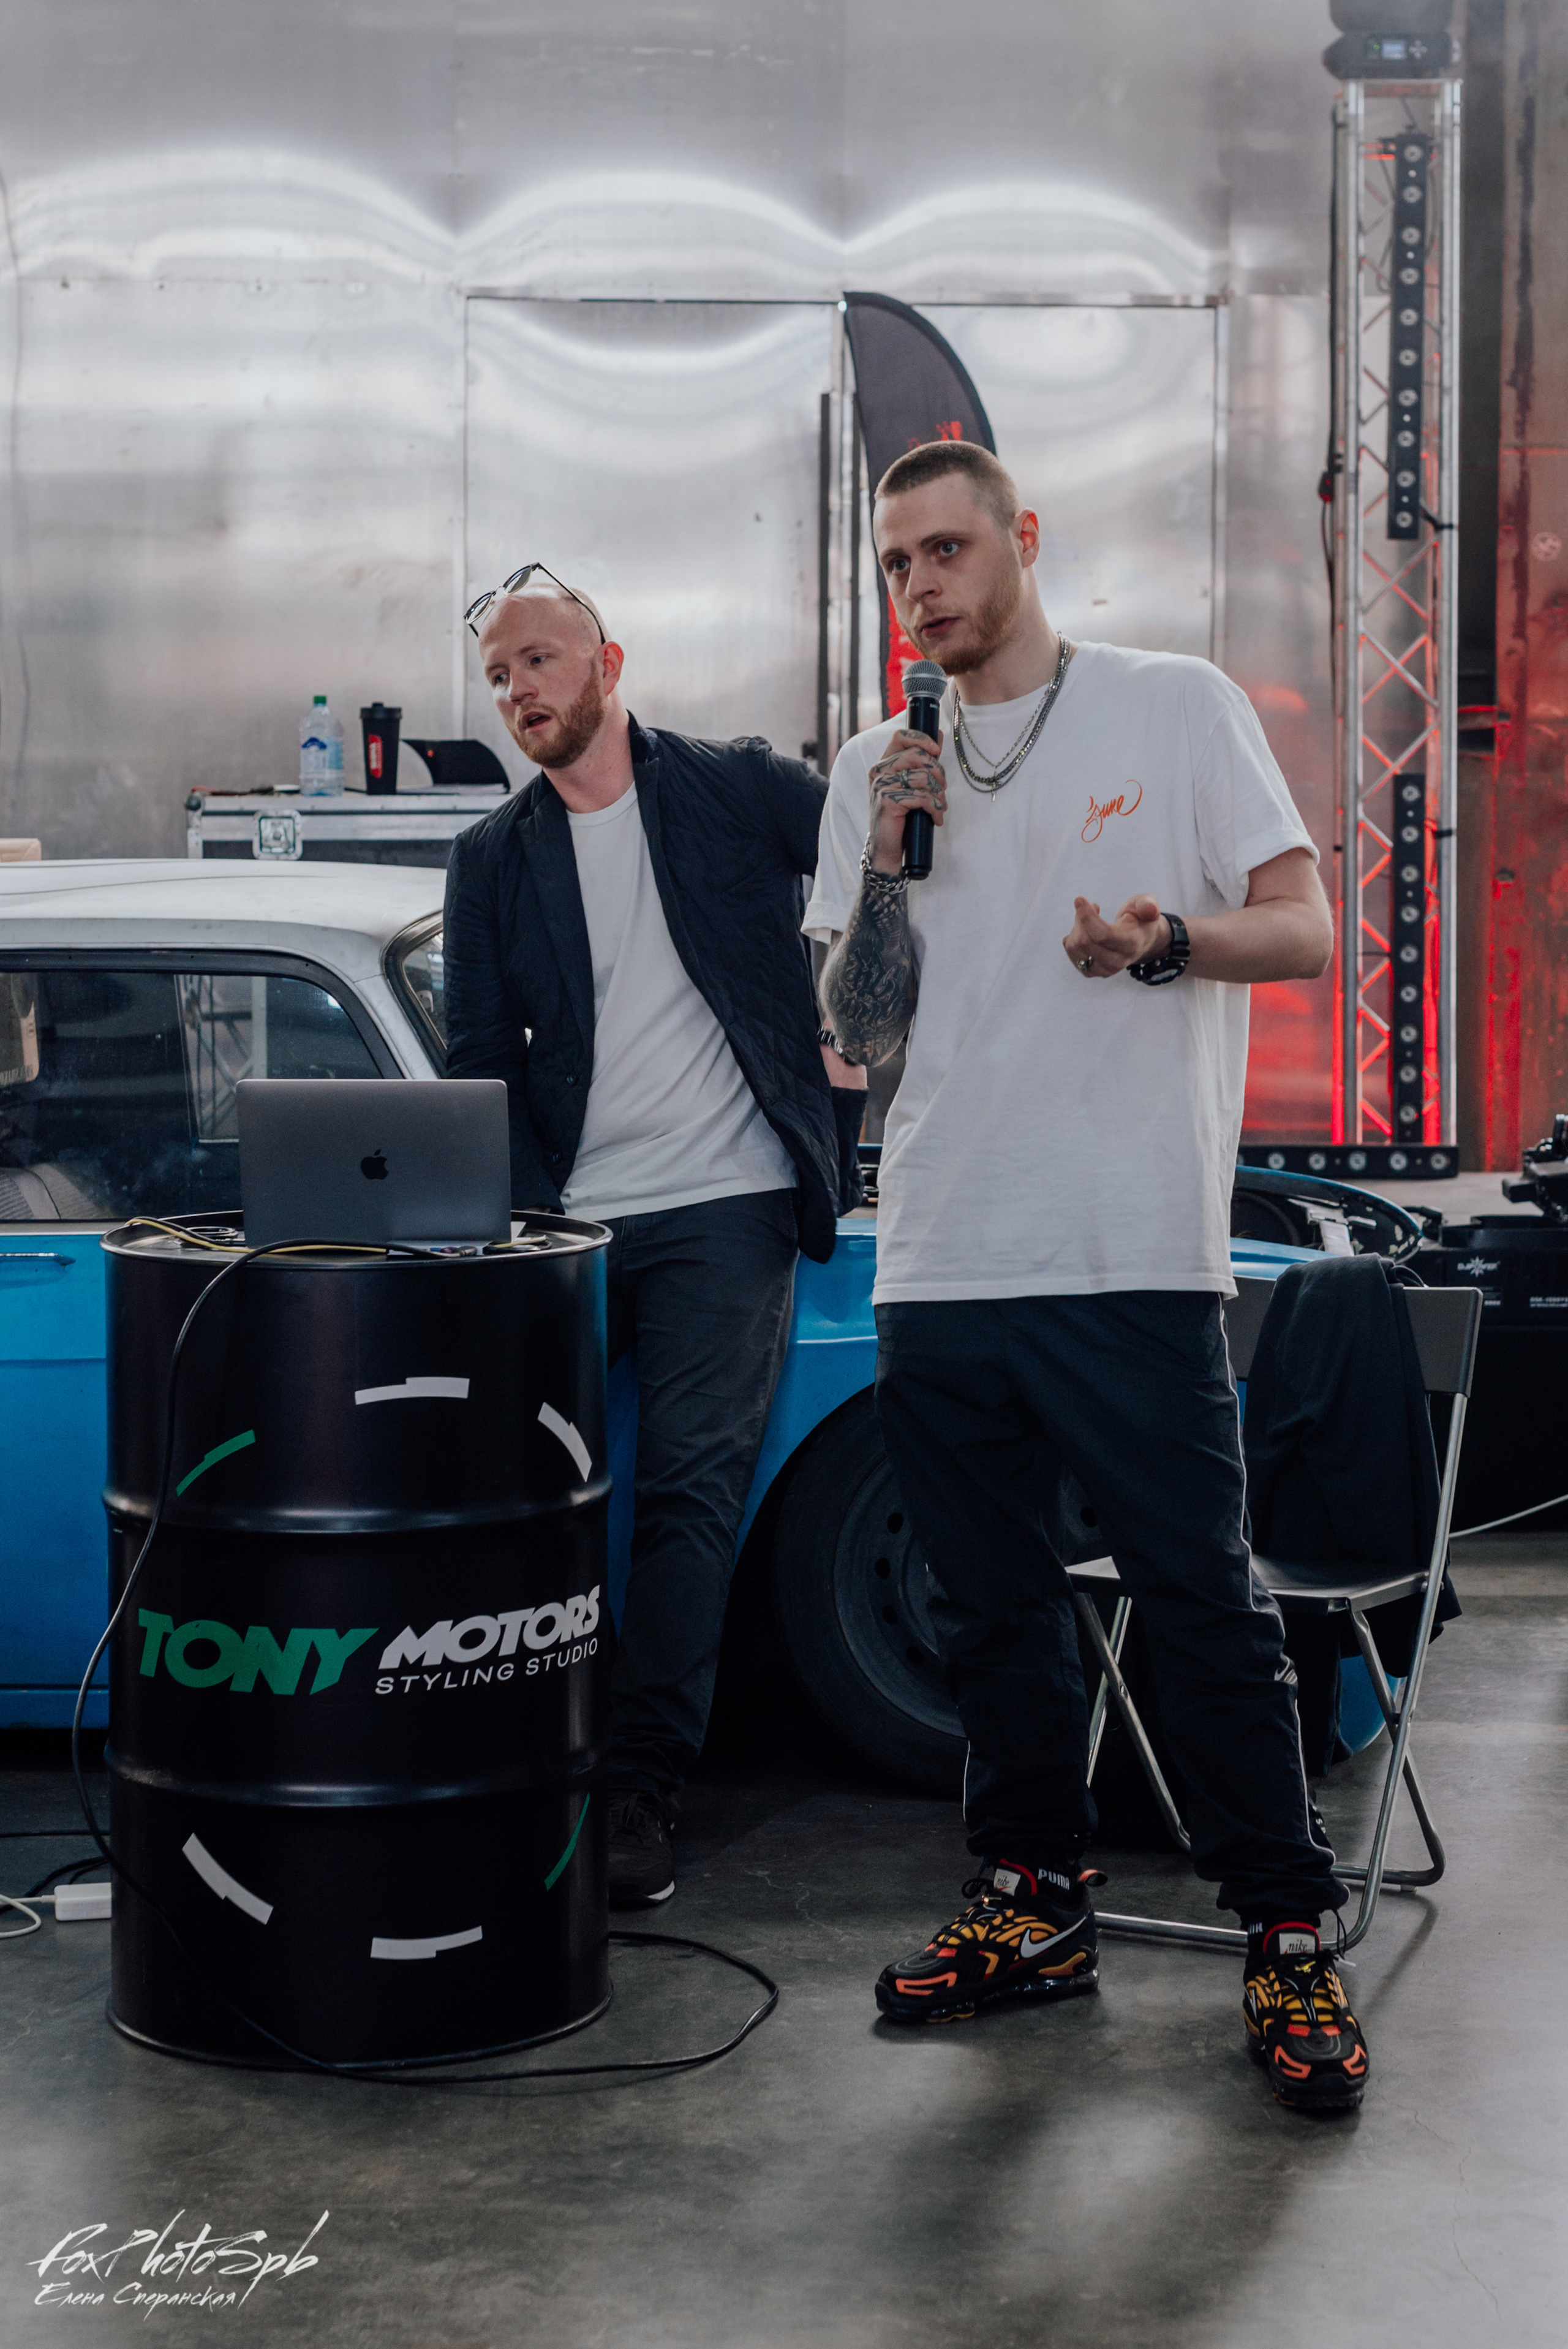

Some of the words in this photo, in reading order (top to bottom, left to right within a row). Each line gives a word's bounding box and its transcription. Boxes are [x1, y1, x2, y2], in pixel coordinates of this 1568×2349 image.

[138, 1608, 379, 1695] TONY
[378, 1584, 600, 1670] MOTORS
[375, 1663, 514, 1694] STYLING
[526, 1638, 598, 1675] STUDIO
[1038, 1869, 1070, 1890] PUMA
